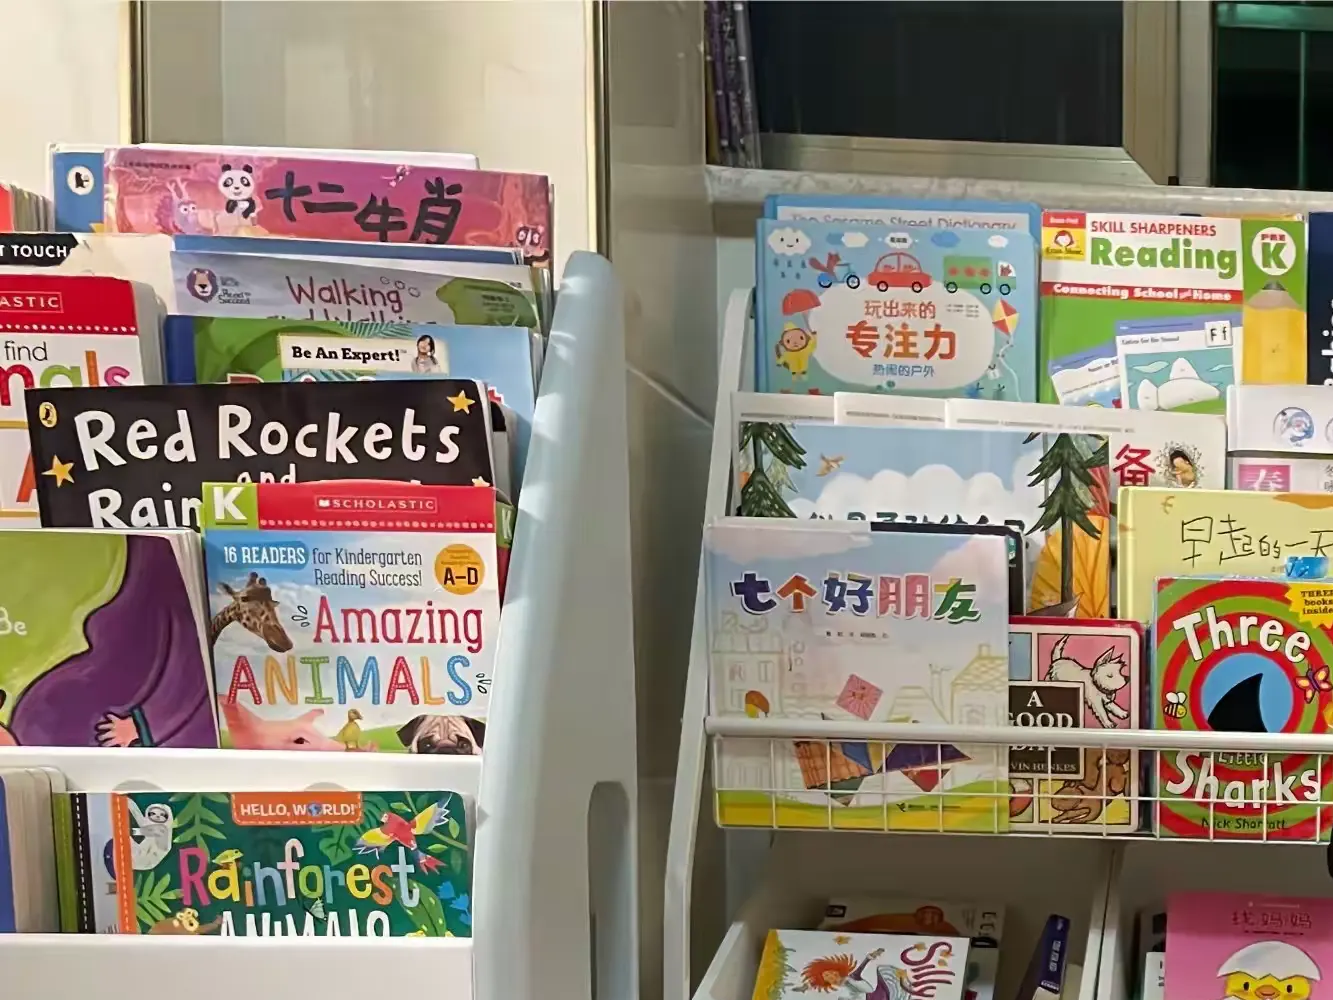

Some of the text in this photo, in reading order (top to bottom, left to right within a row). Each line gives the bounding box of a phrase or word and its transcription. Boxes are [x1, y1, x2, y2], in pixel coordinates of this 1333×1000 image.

[1091, 221, 1217, 237] SKILL SHARPENERS
[11, 245, 67, 258] TOUCH
[1091, 237, 1237, 280] Reading
[1261, 242, 1288, 270] K
[286, 274, 402, 314] Walking
[1053, 283, 1231, 301] Connecting School Home
[864, 300, 936, 319] 玩出来的
[845, 320, 957, 360] 专注力
[1210, 326, 1228, 341] F f
[4, 340, 49, 361] find
[291, 347, 400, 364] Be An Expert!
[872, 364, 935, 378] 热闹的户外
[74, 404, 461, 472] Red Rockets
[212, 487, 246, 520] K
[332, 499, 434, 510] SCHOLASTIC
[223, 547, 238, 564] 16
[241, 547, 305, 564] READERS
[312, 549, 331, 565] for
[335, 549, 422, 568] Kindergarten
[314, 569, 422, 589] Reading Success!
[730, 571, 982, 624] 七个好朋友
[1304, 598, 1333, 607] books
[313, 595, 484, 653] Amazing
[1173, 606, 1311, 663] Three
[227, 655, 474, 705] ANIMALS
[1027, 690, 1044, 707] A
[1166, 751, 1320, 809] Sharks
[240, 803, 290, 818] HELLO,
[179, 838, 420, 907] Rainforest
[900, 941, 956, 998] Silly
